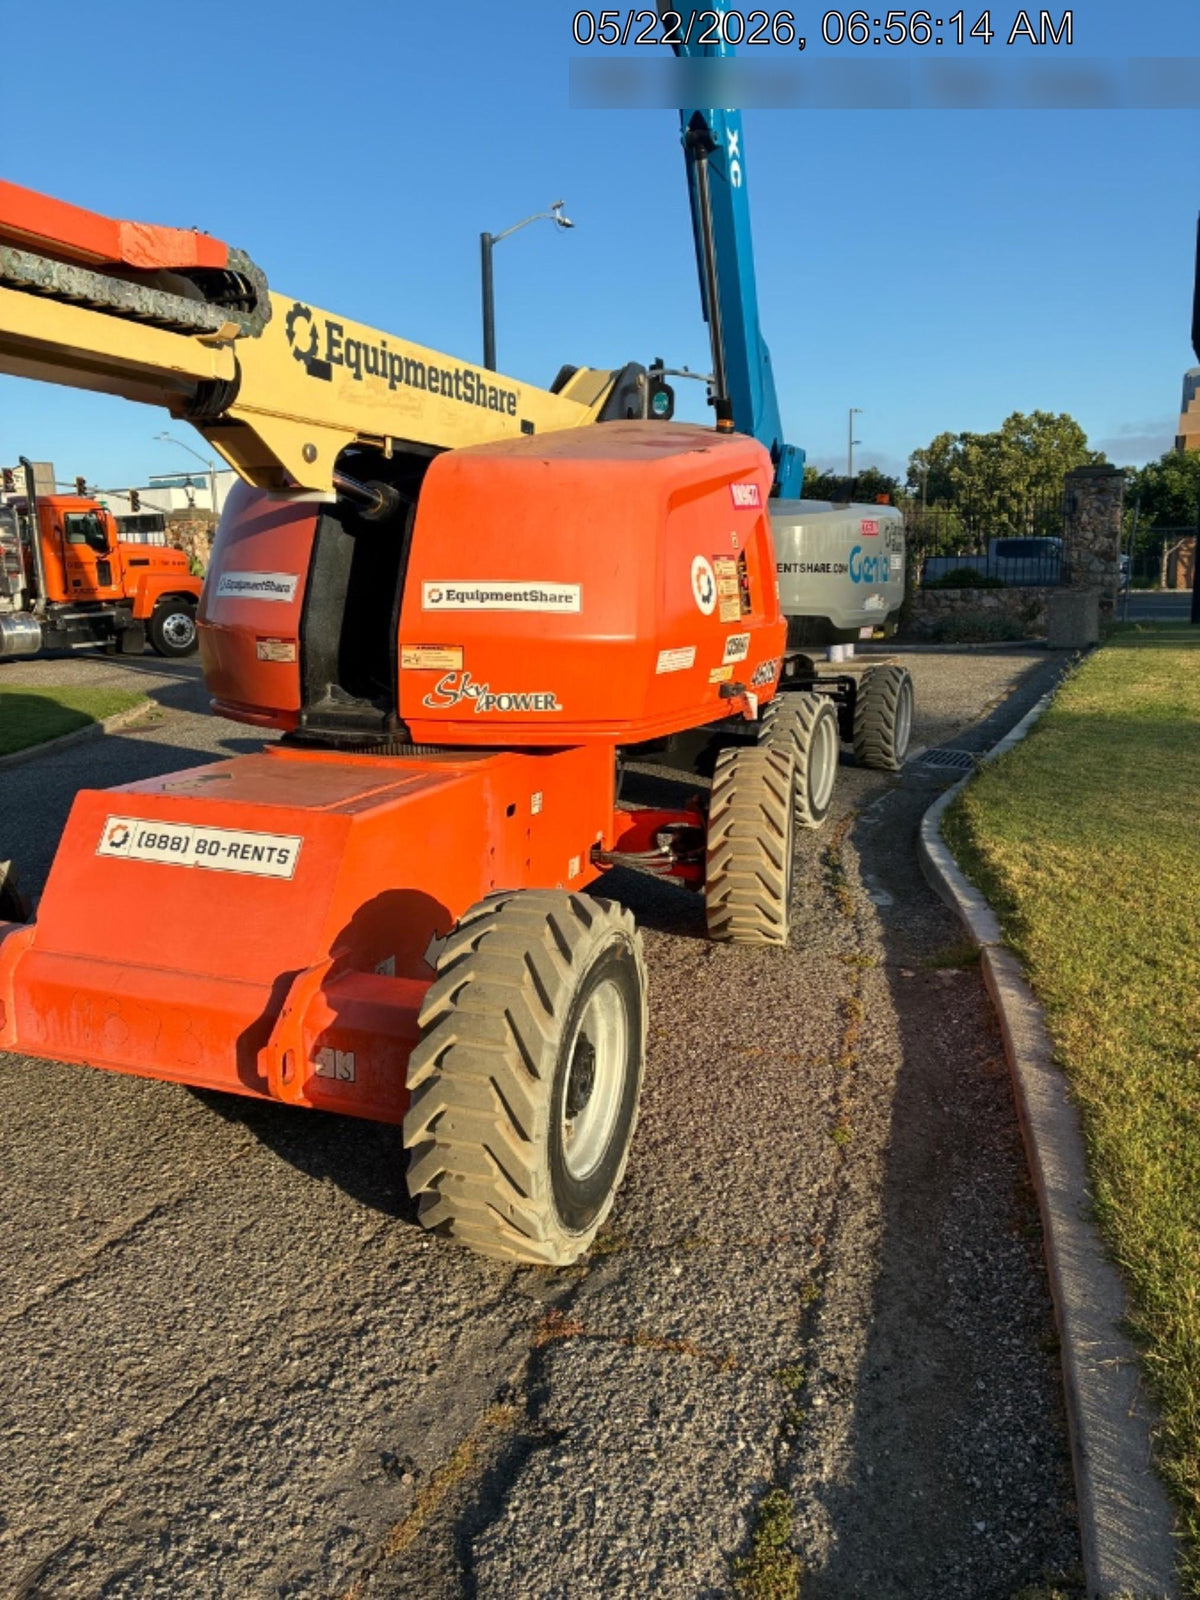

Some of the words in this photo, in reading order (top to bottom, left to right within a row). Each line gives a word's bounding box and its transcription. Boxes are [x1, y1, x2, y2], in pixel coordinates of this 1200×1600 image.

[324, 319, 517, 417] EquipmentShare
[776, 562, 849, 574] ENTSHARE.COM
[849, 545, 889, 584] Genie
[445, 589, 573, 603] EquipmentShare
[423, 672, 489, 713] Sky
[484, 693, 562, 712] POWER
[137, 831, 190, 853] (888)
[194, 838, 290, 866] 80-RENTS
